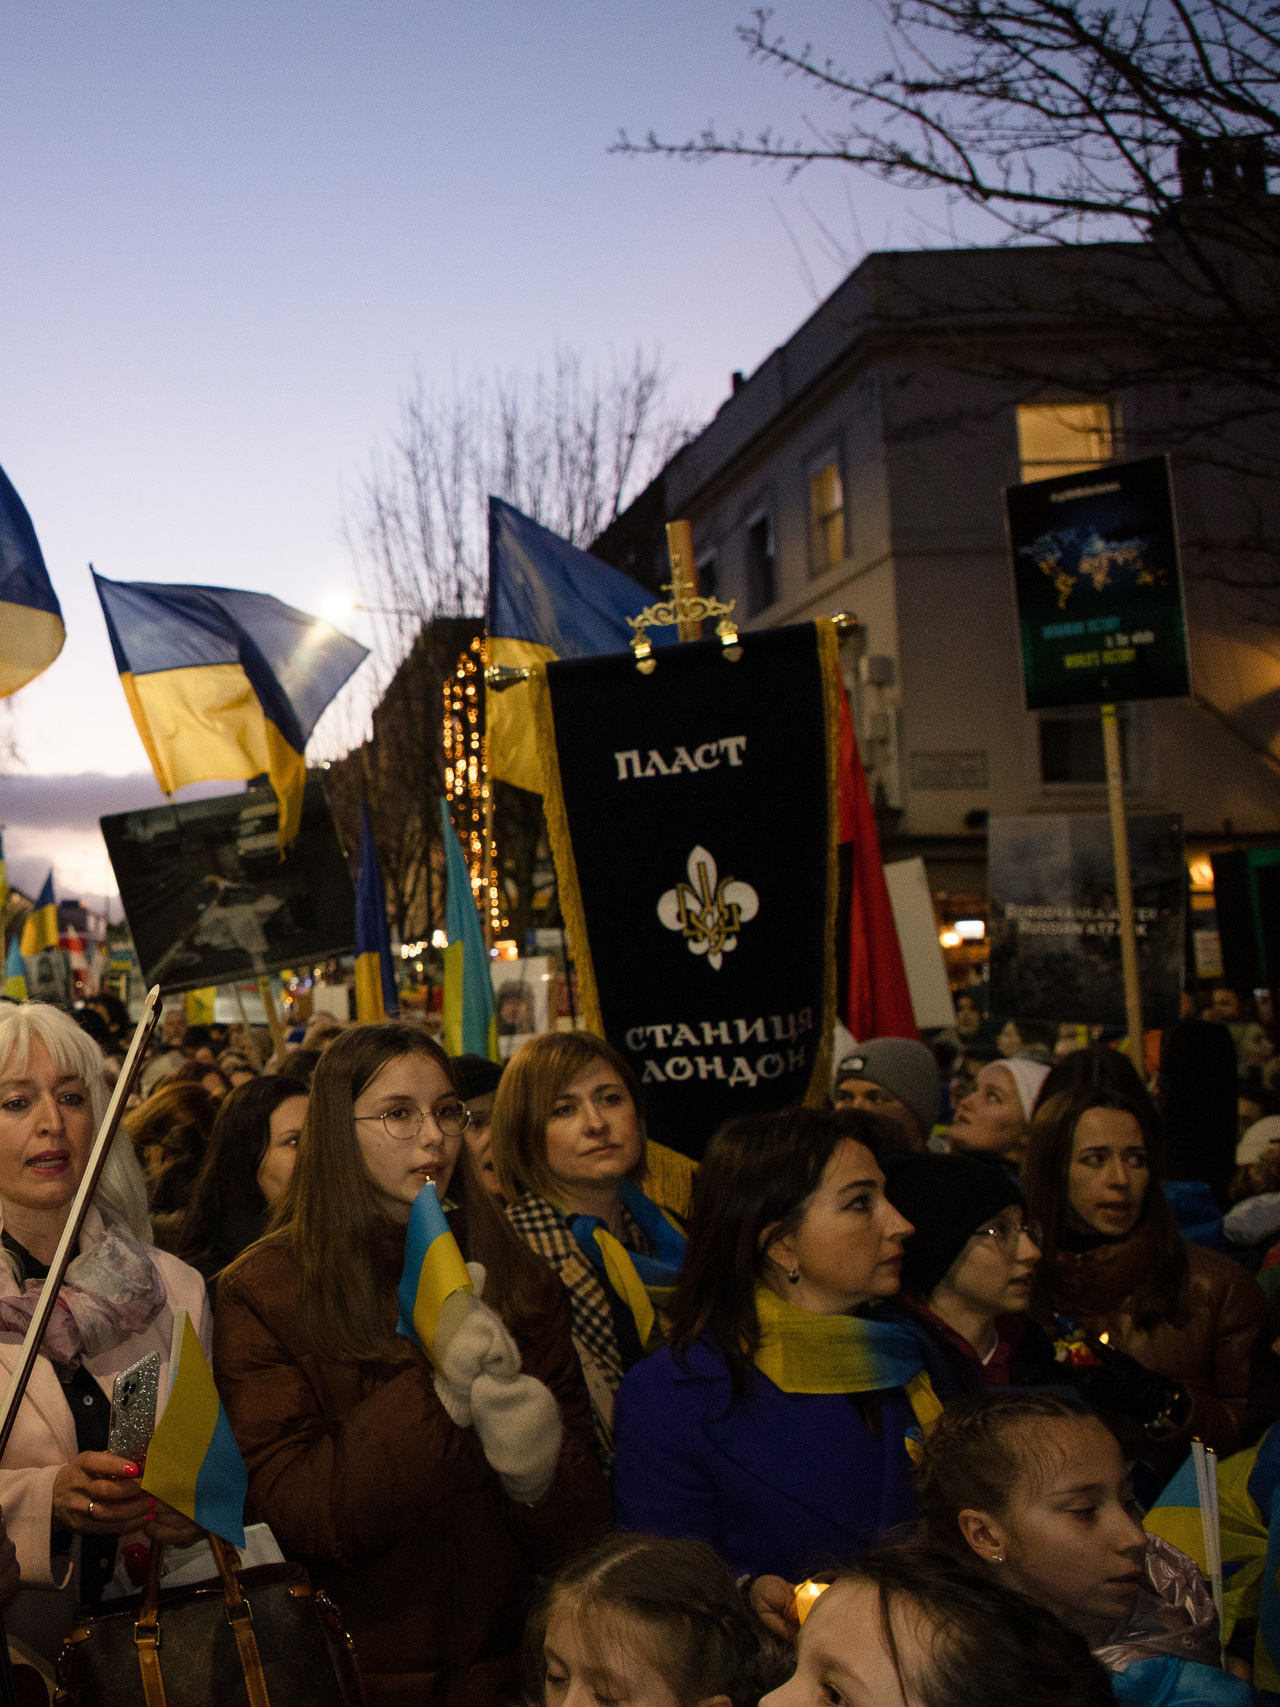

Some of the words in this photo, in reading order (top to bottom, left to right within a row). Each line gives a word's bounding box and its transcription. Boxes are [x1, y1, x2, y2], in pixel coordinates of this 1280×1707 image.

[614, 735, 747, 780] ПЛАСТ
[625, 1006, 814, 1051] СТАНИЦЯ
[641, 1044, 806, 1089] ЛОНДОН
